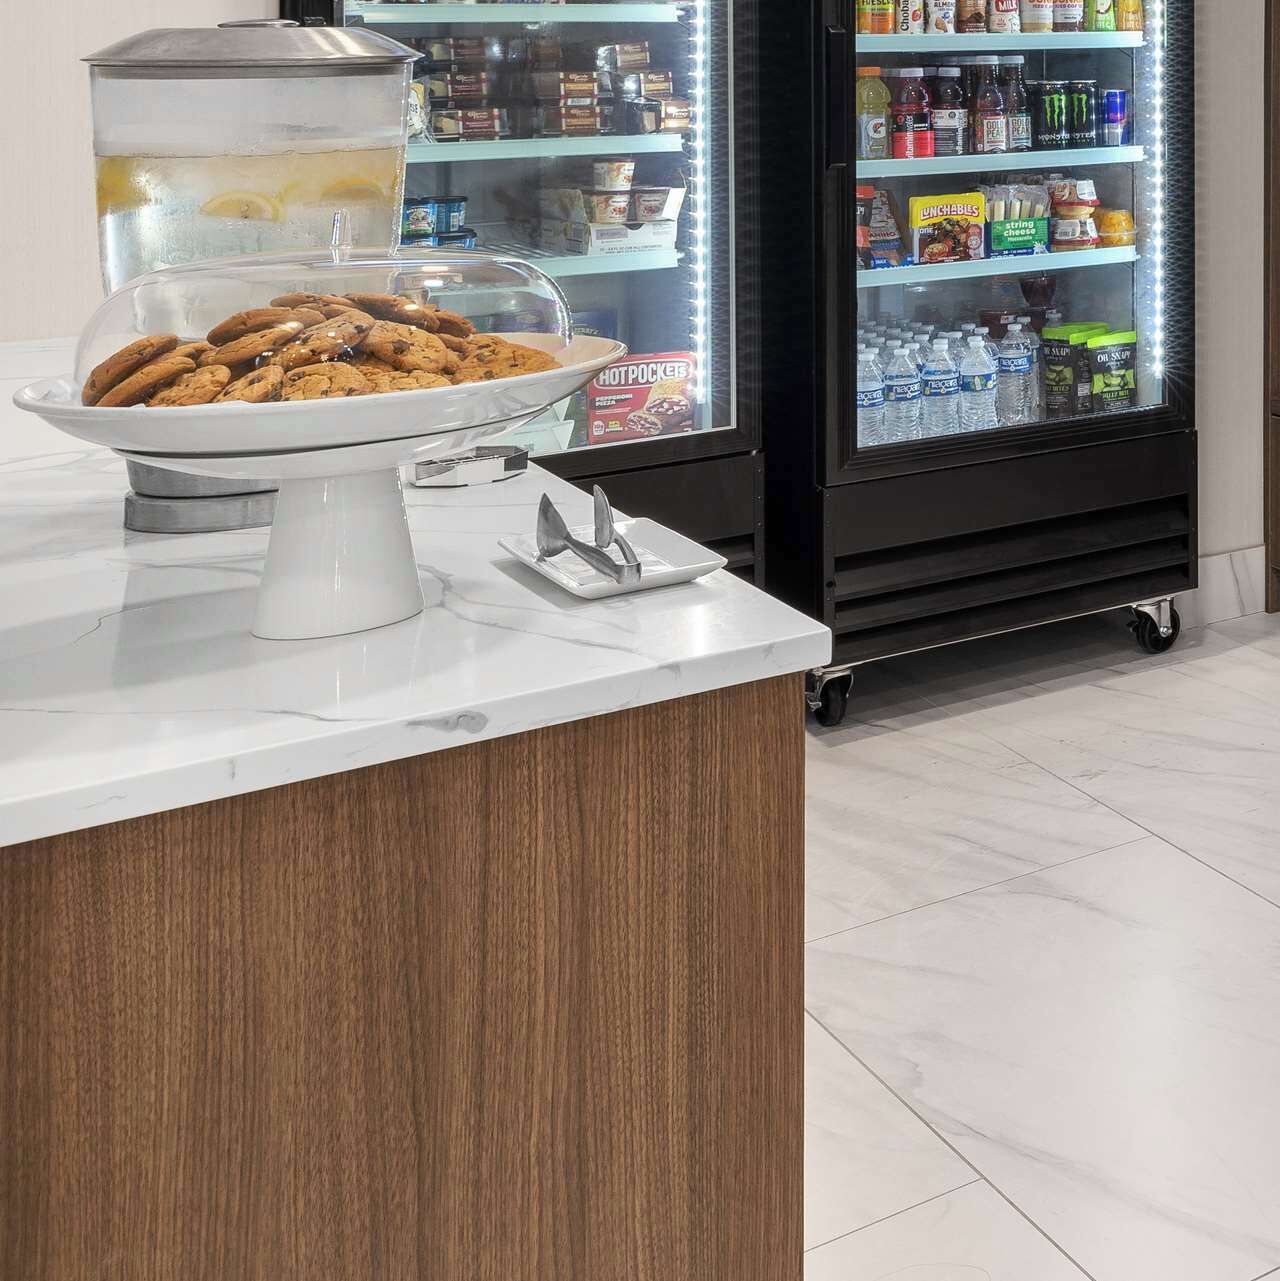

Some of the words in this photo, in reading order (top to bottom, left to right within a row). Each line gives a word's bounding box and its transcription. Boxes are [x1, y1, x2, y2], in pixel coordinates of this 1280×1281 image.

[998, 0, 1017, 11] MILK
[920, 203, 981, 220] LUNCHABLES
[1005, 220, 1034, 229] string
[1003, 228, 1036, 237] cheese
[600, 366, 627, 385] HOT
[629, 362, 689, 384] POCKETS
[893, 381, 920, 396] niagar
[928, 379, 958, 392] niagara
